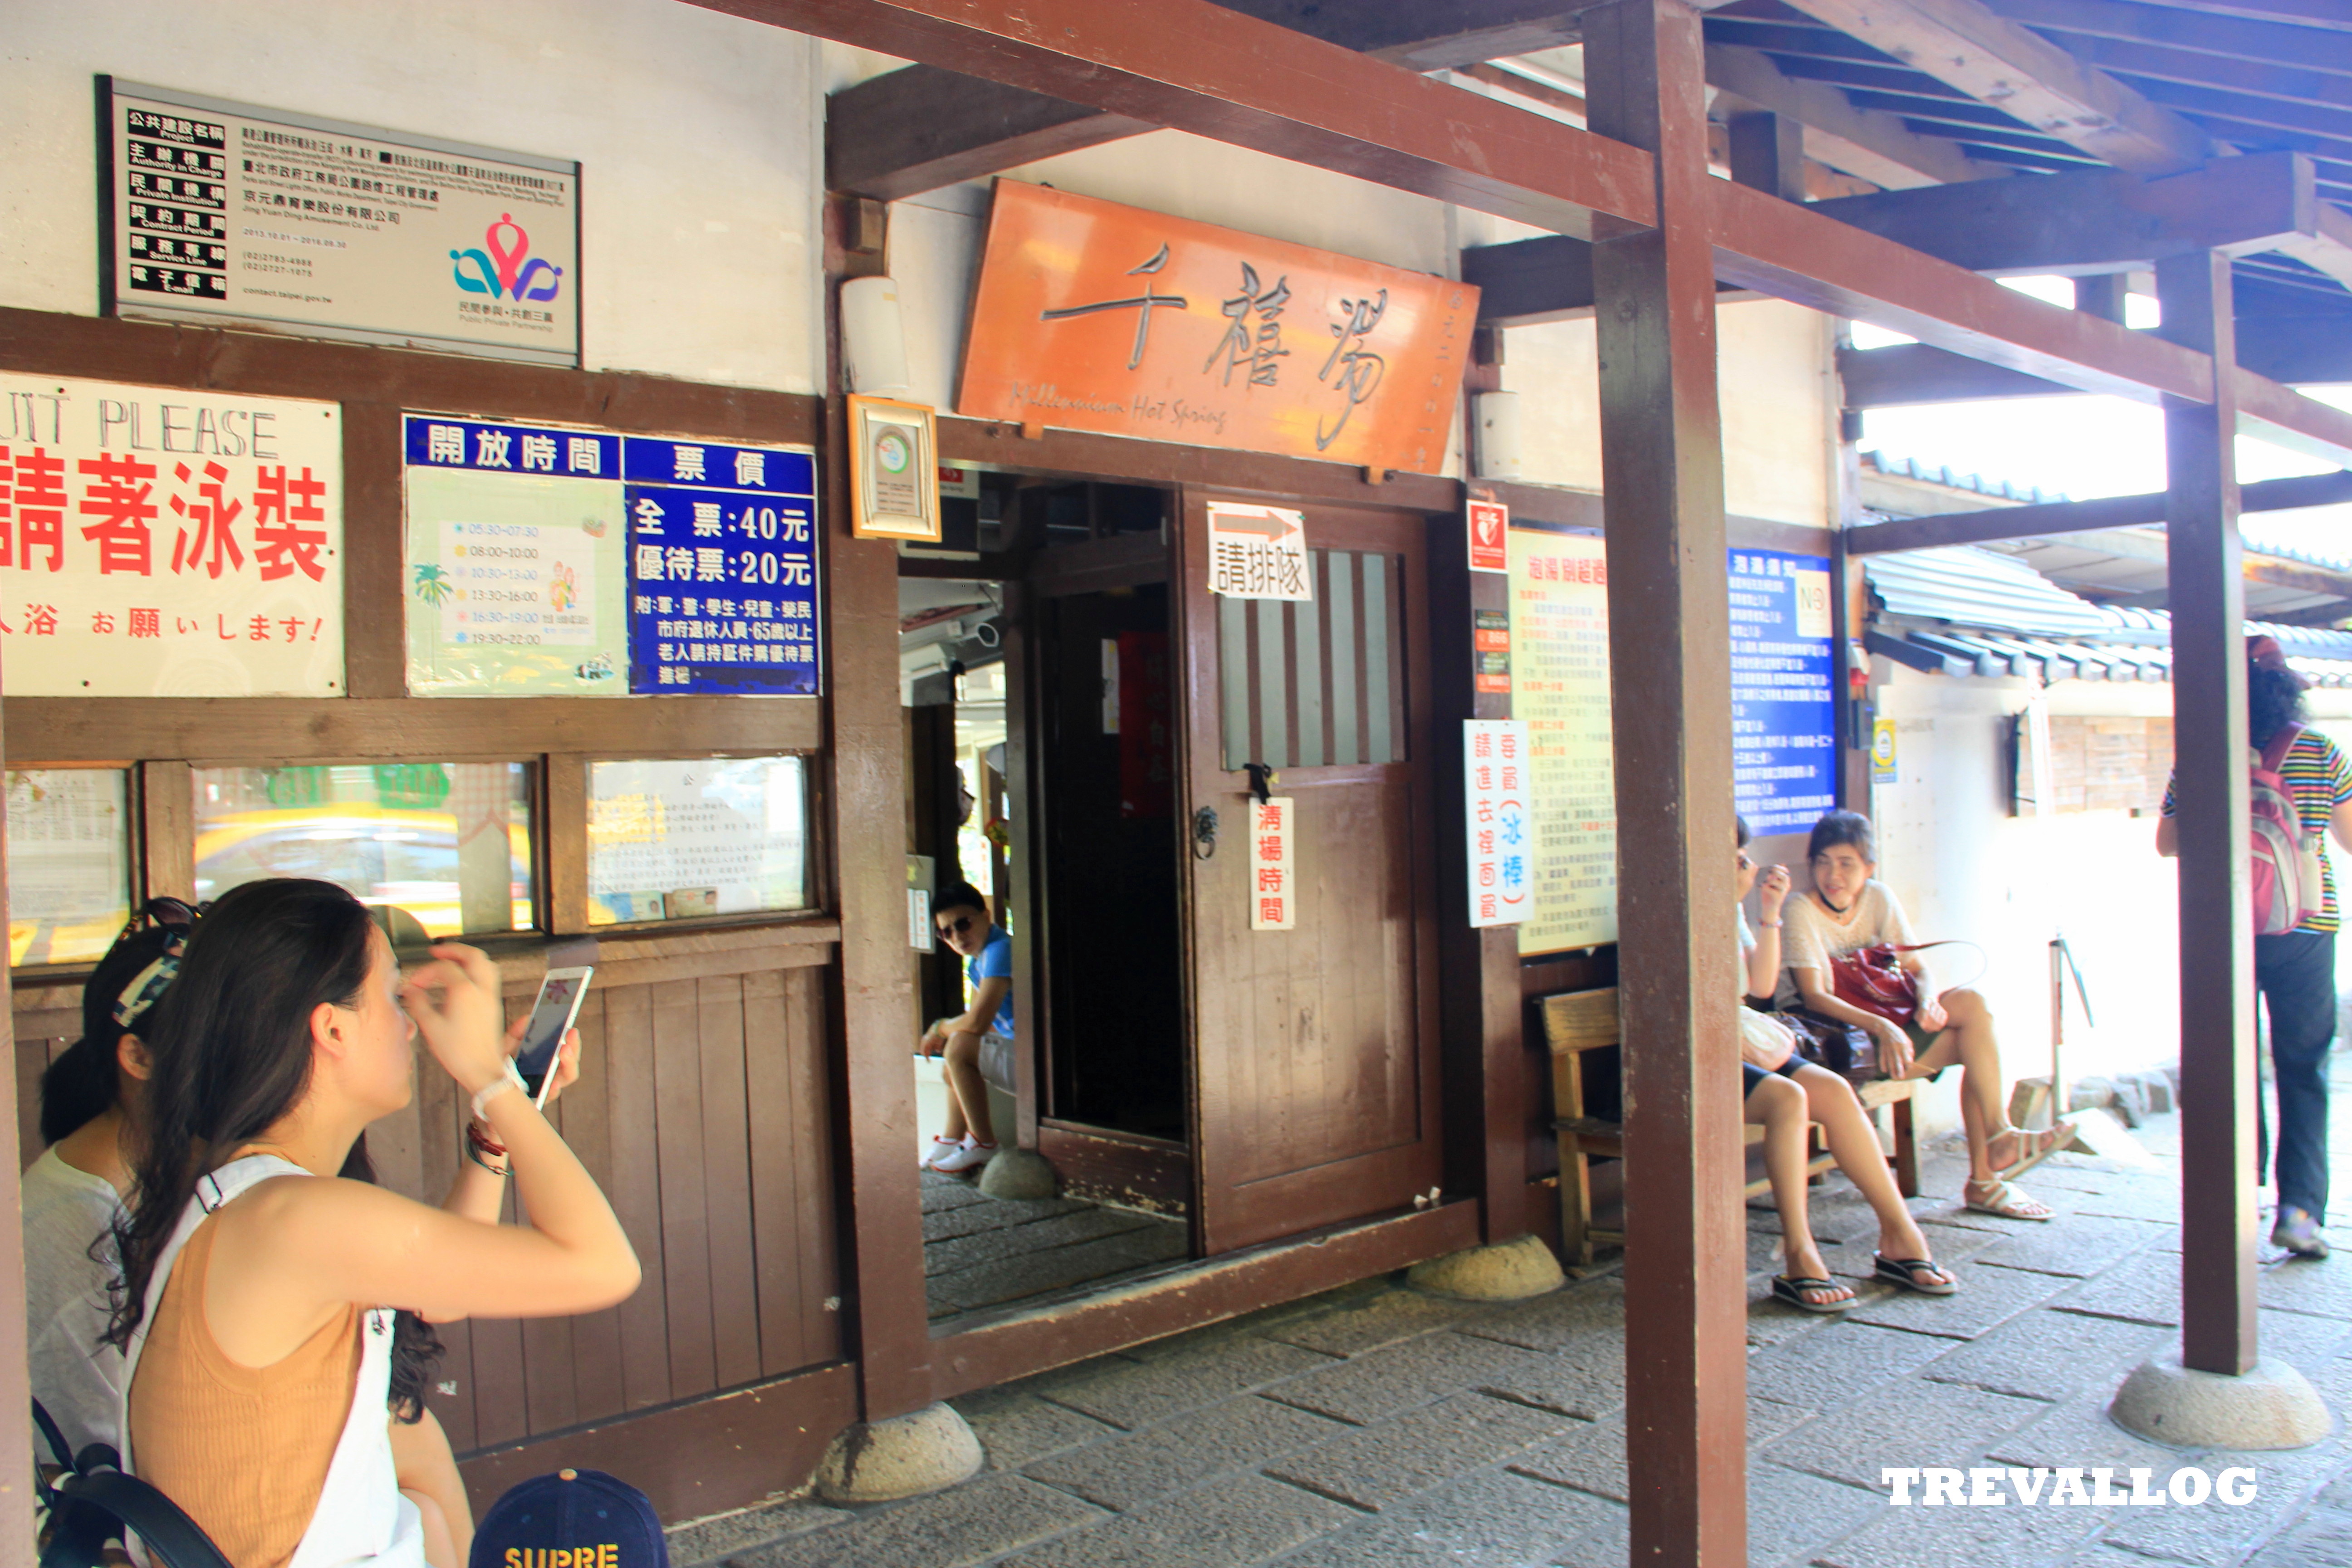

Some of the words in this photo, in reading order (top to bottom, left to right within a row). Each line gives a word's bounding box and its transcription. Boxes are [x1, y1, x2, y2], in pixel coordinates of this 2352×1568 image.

[98, 399, 279, 460] PLEASE
[1009, 381, 1125, 413] Millennium
[1132, 394, 1166, 422] Hot
[1171, 398, 1227, 435] Spring
[428, 424, 602, 475] 開放時間
[672, 445, 766, 487] 票價
[0, 445, 328, 583] 請著泳裝
[1216, 541, 1304, 594] 請排隊
[1258, 804, 1284, 923] 清場時間
[504, 1543, 619, 1568] SUPRE
